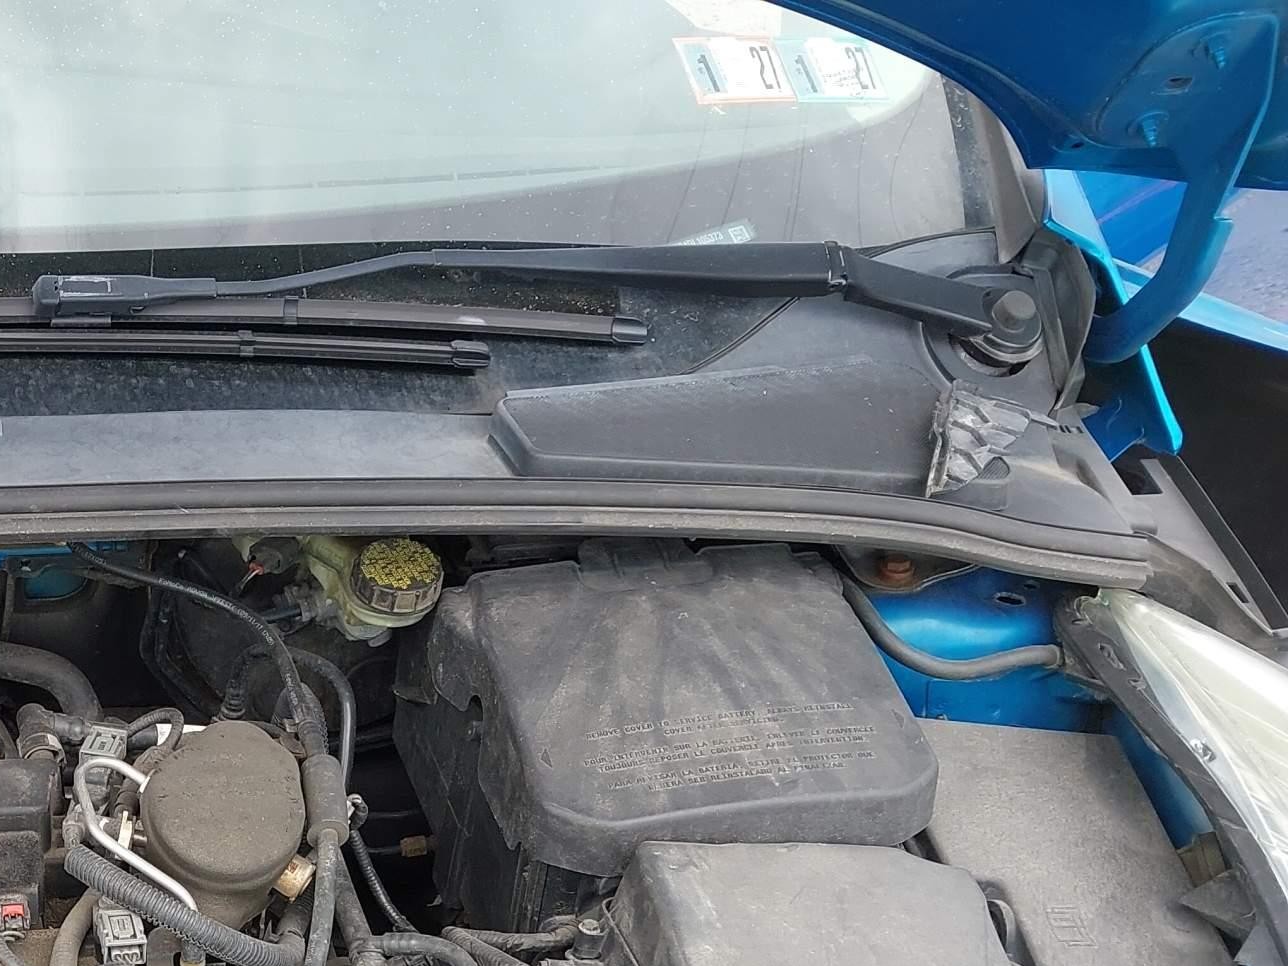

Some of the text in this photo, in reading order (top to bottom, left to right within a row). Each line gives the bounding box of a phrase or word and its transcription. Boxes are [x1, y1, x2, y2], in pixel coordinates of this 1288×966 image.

[698, 53, 720, 92] 1
[749, 46, 781, 89] 27
[844, 47, 876, 90] 27
[586, 728, 620, 740] REMOVE
[624, 723, 653, 733] COVER
[664, 726, 692, 735] COVER
[673, 743, 691, 751] SUR
